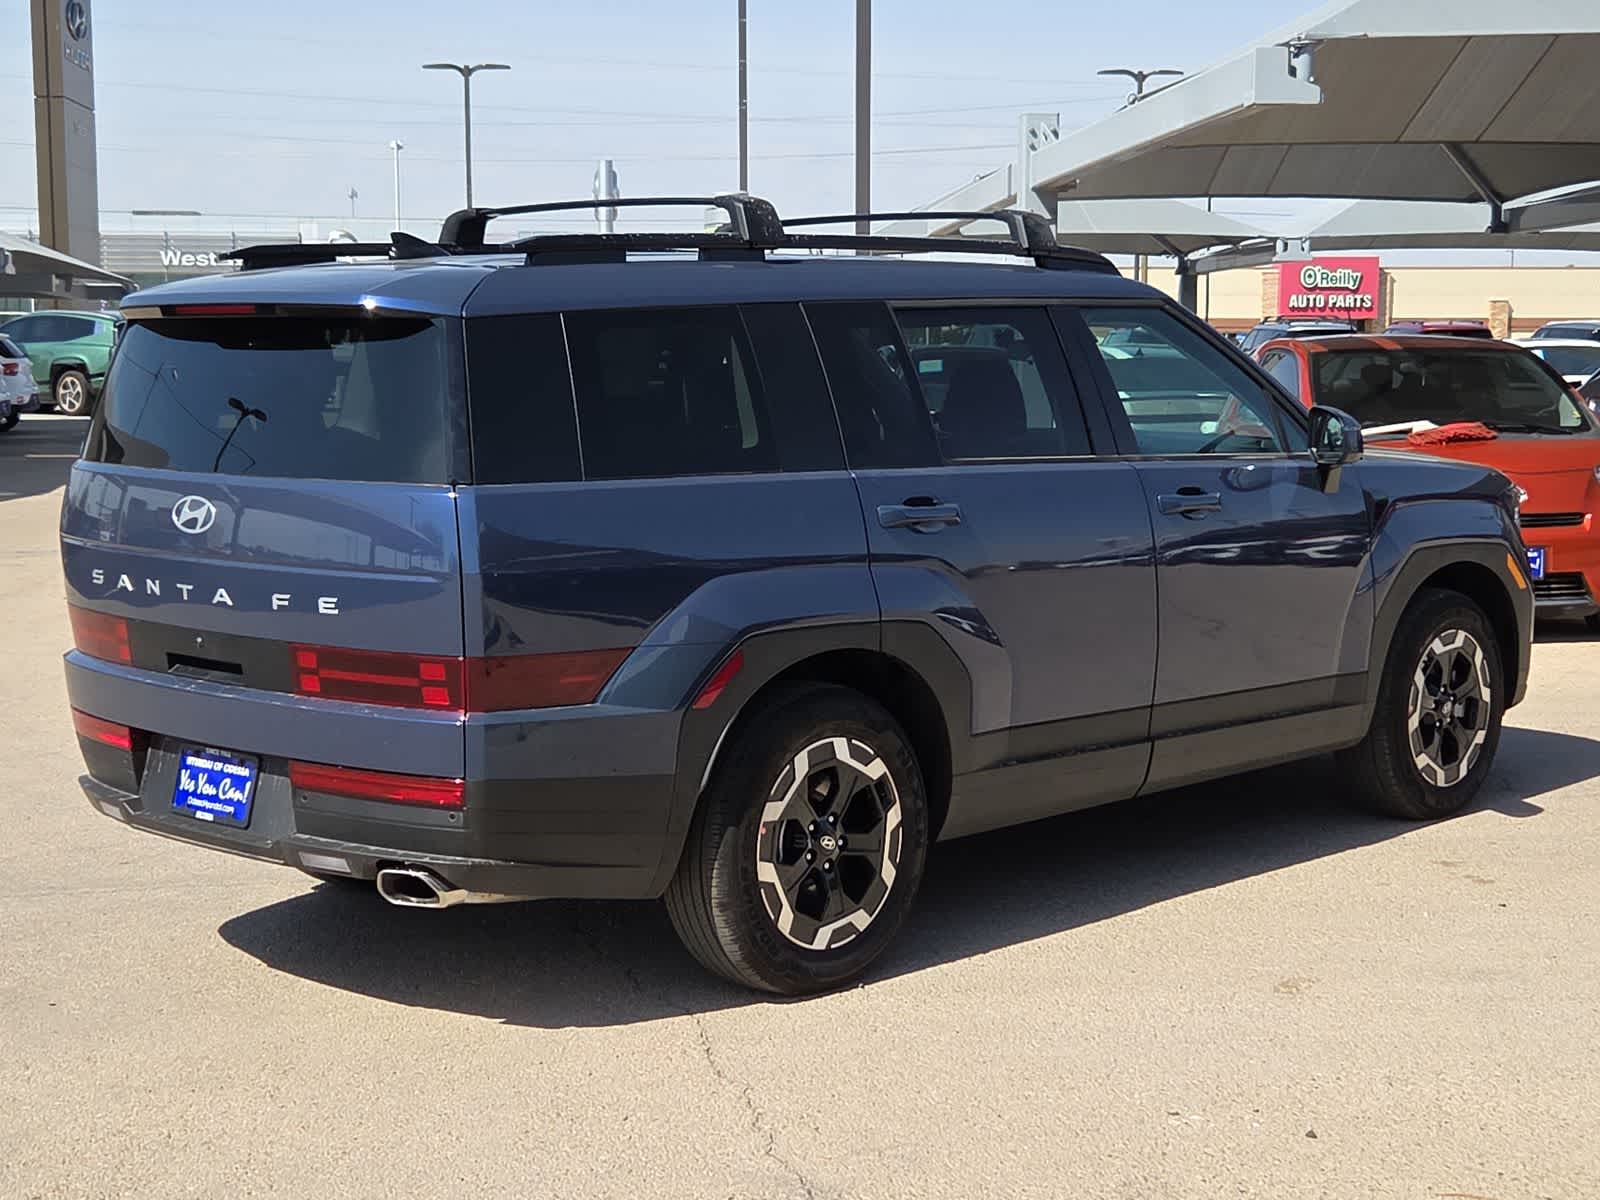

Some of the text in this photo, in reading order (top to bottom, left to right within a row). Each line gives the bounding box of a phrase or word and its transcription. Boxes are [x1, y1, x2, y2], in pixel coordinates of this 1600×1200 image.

[1300, 265, 1361, 289] O'Reilly
[1288, 294, 1372, 308] AUTO PARTS
[91, 568, 339, 615] SANTA FE
[179, 769, 252, 804] Yes You Can!
